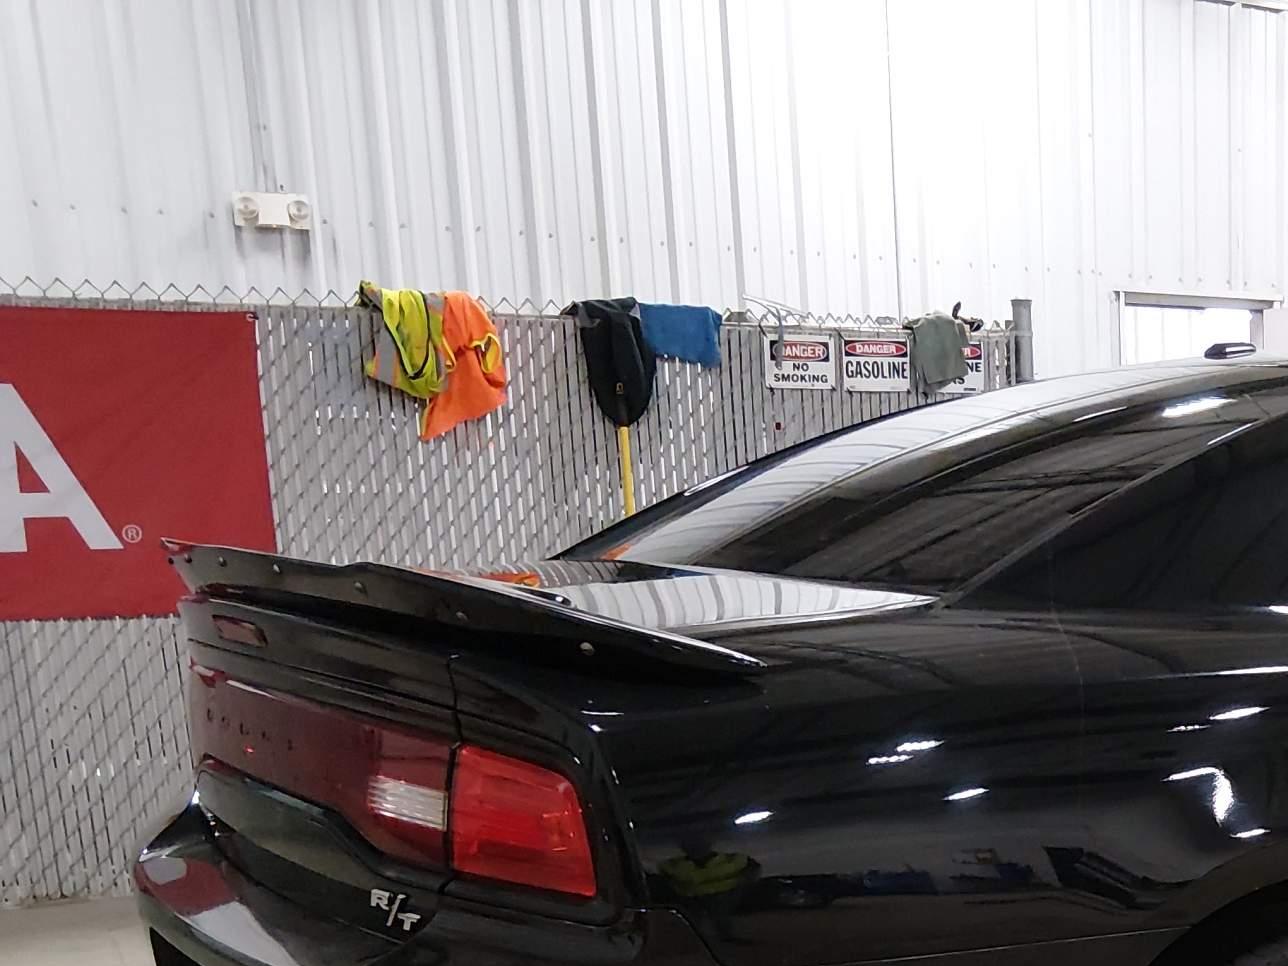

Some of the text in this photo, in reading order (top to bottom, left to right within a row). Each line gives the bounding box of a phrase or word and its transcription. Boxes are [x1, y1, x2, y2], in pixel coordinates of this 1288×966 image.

[781, 344, 823, 357] ANGER
[855, 344, 897, 354] DANGER
[793, 362, 809, 372] NO
[845, 360, 908, 379] GASOLINE
[773, 373, 829, 384] SMOKING
[370, 888, 421, 931] R/T
